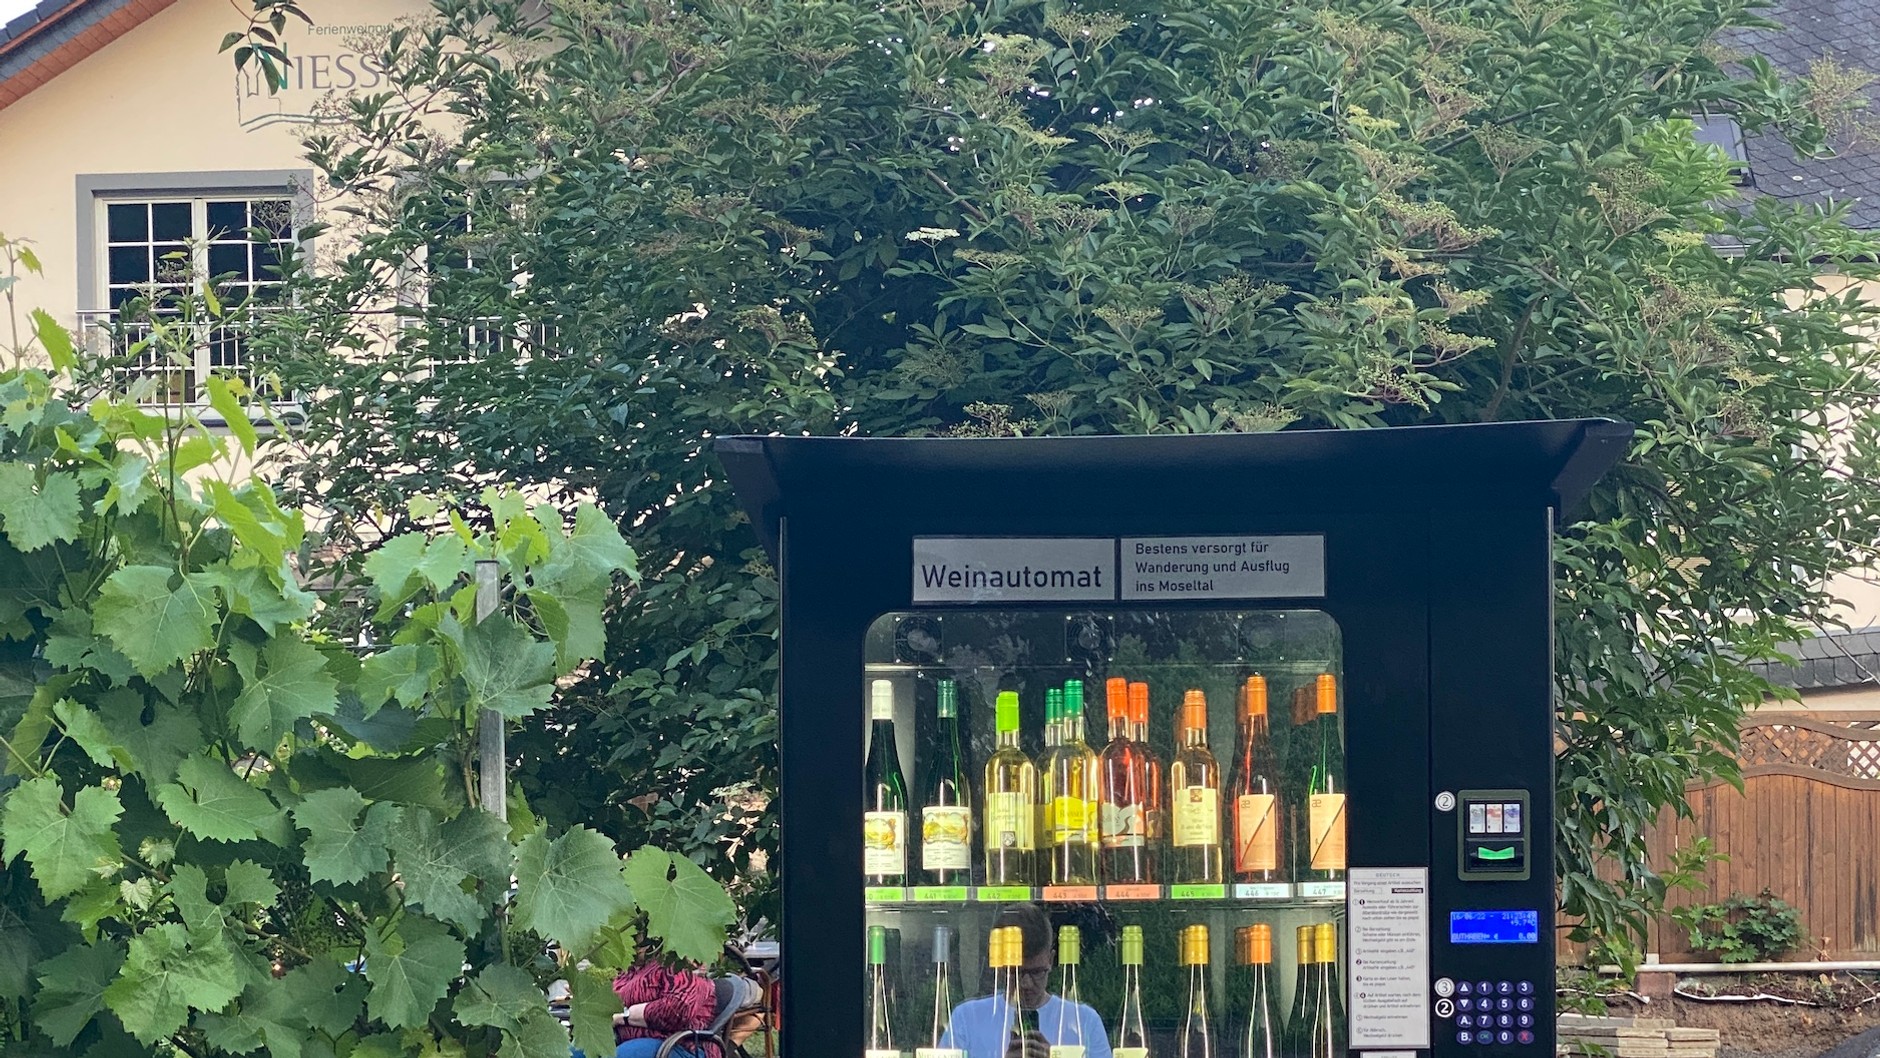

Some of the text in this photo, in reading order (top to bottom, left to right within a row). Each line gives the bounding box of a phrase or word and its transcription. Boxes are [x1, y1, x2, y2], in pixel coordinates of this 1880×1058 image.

[1135, 541, 1270, 557] Bestens versorgt für
[1135, 559, 1290, 576] Wanderung und Ausflug
[922, 564, 1102, 588] Weinautomat
[1135, 579, 1214, 592] ins Moseltal
[1501, 983, 1507, 991] 2
[1521, 983, 1527, 991] 3
[1441, 1002, 1448, 1013] 2
[1481, 999, 1527, 1008] 4 5 6
[1481, 1016, 1487, 1024] 7
[1502, 1016, 1508, 1024] 8
[1522, 1016, 1527, 1024] 9
